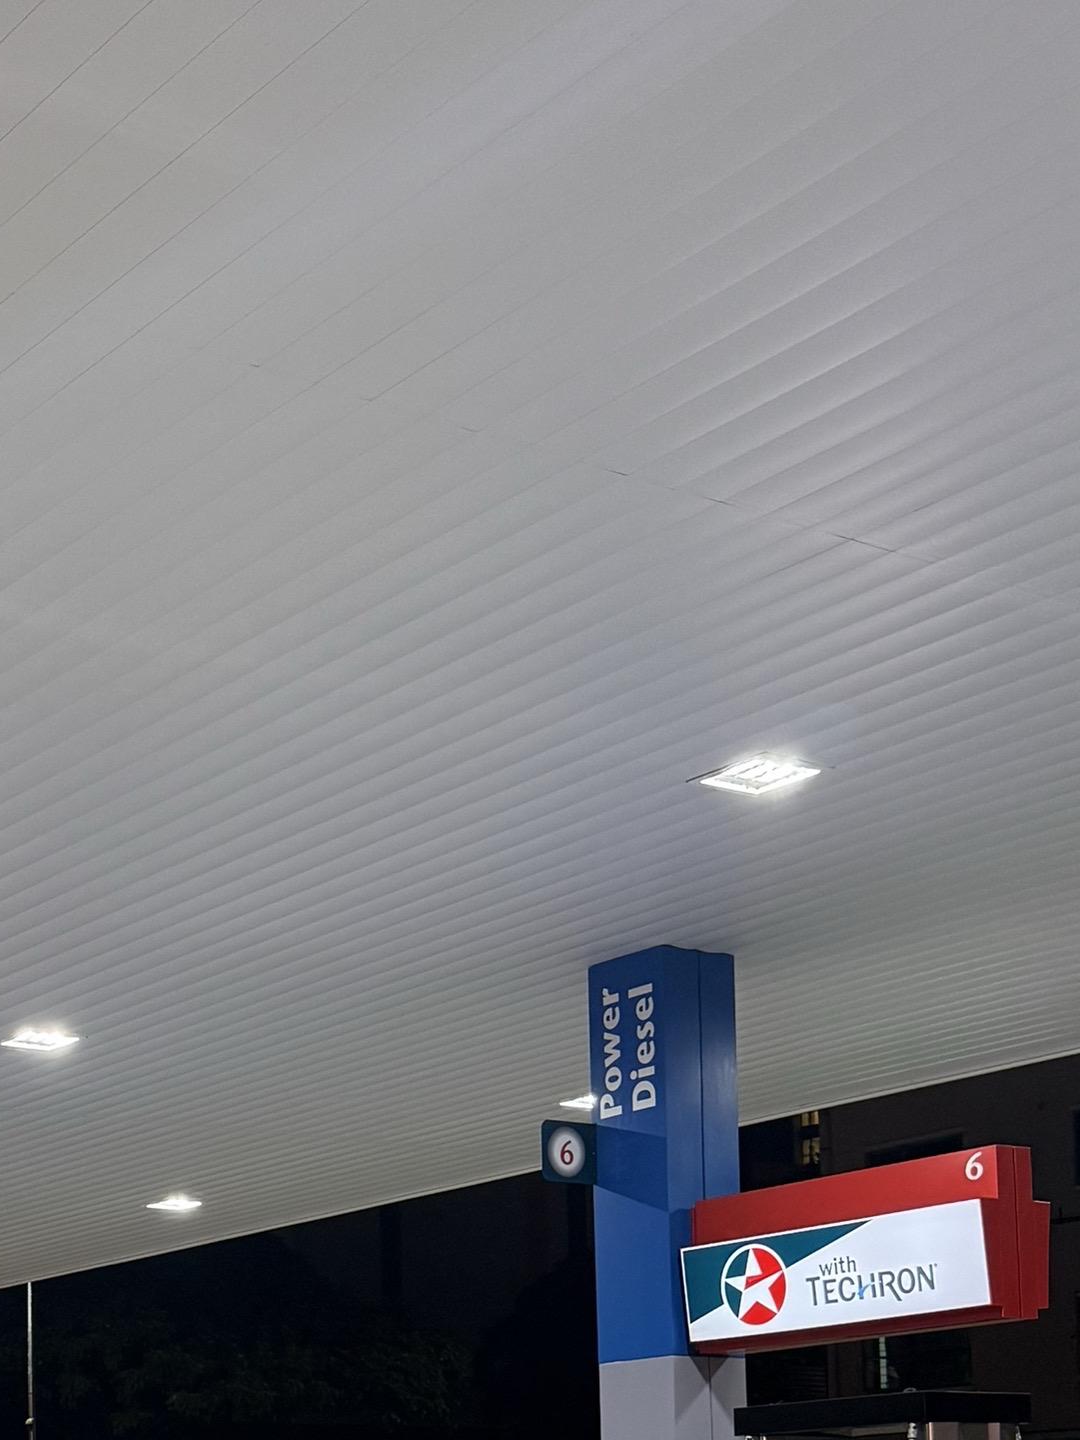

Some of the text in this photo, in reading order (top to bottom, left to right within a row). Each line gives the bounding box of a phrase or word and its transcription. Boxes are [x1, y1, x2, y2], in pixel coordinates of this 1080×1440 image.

[599, 987, 623, 1121] Power
[627, 982, 657, 1113] Diesel
[559, 1139, 575, 1167] 6
[964, 1151, 985, 1182] 6
[805, 1263, 934, 1308] TECHRON
[818, 1256, 857, 1280] with
